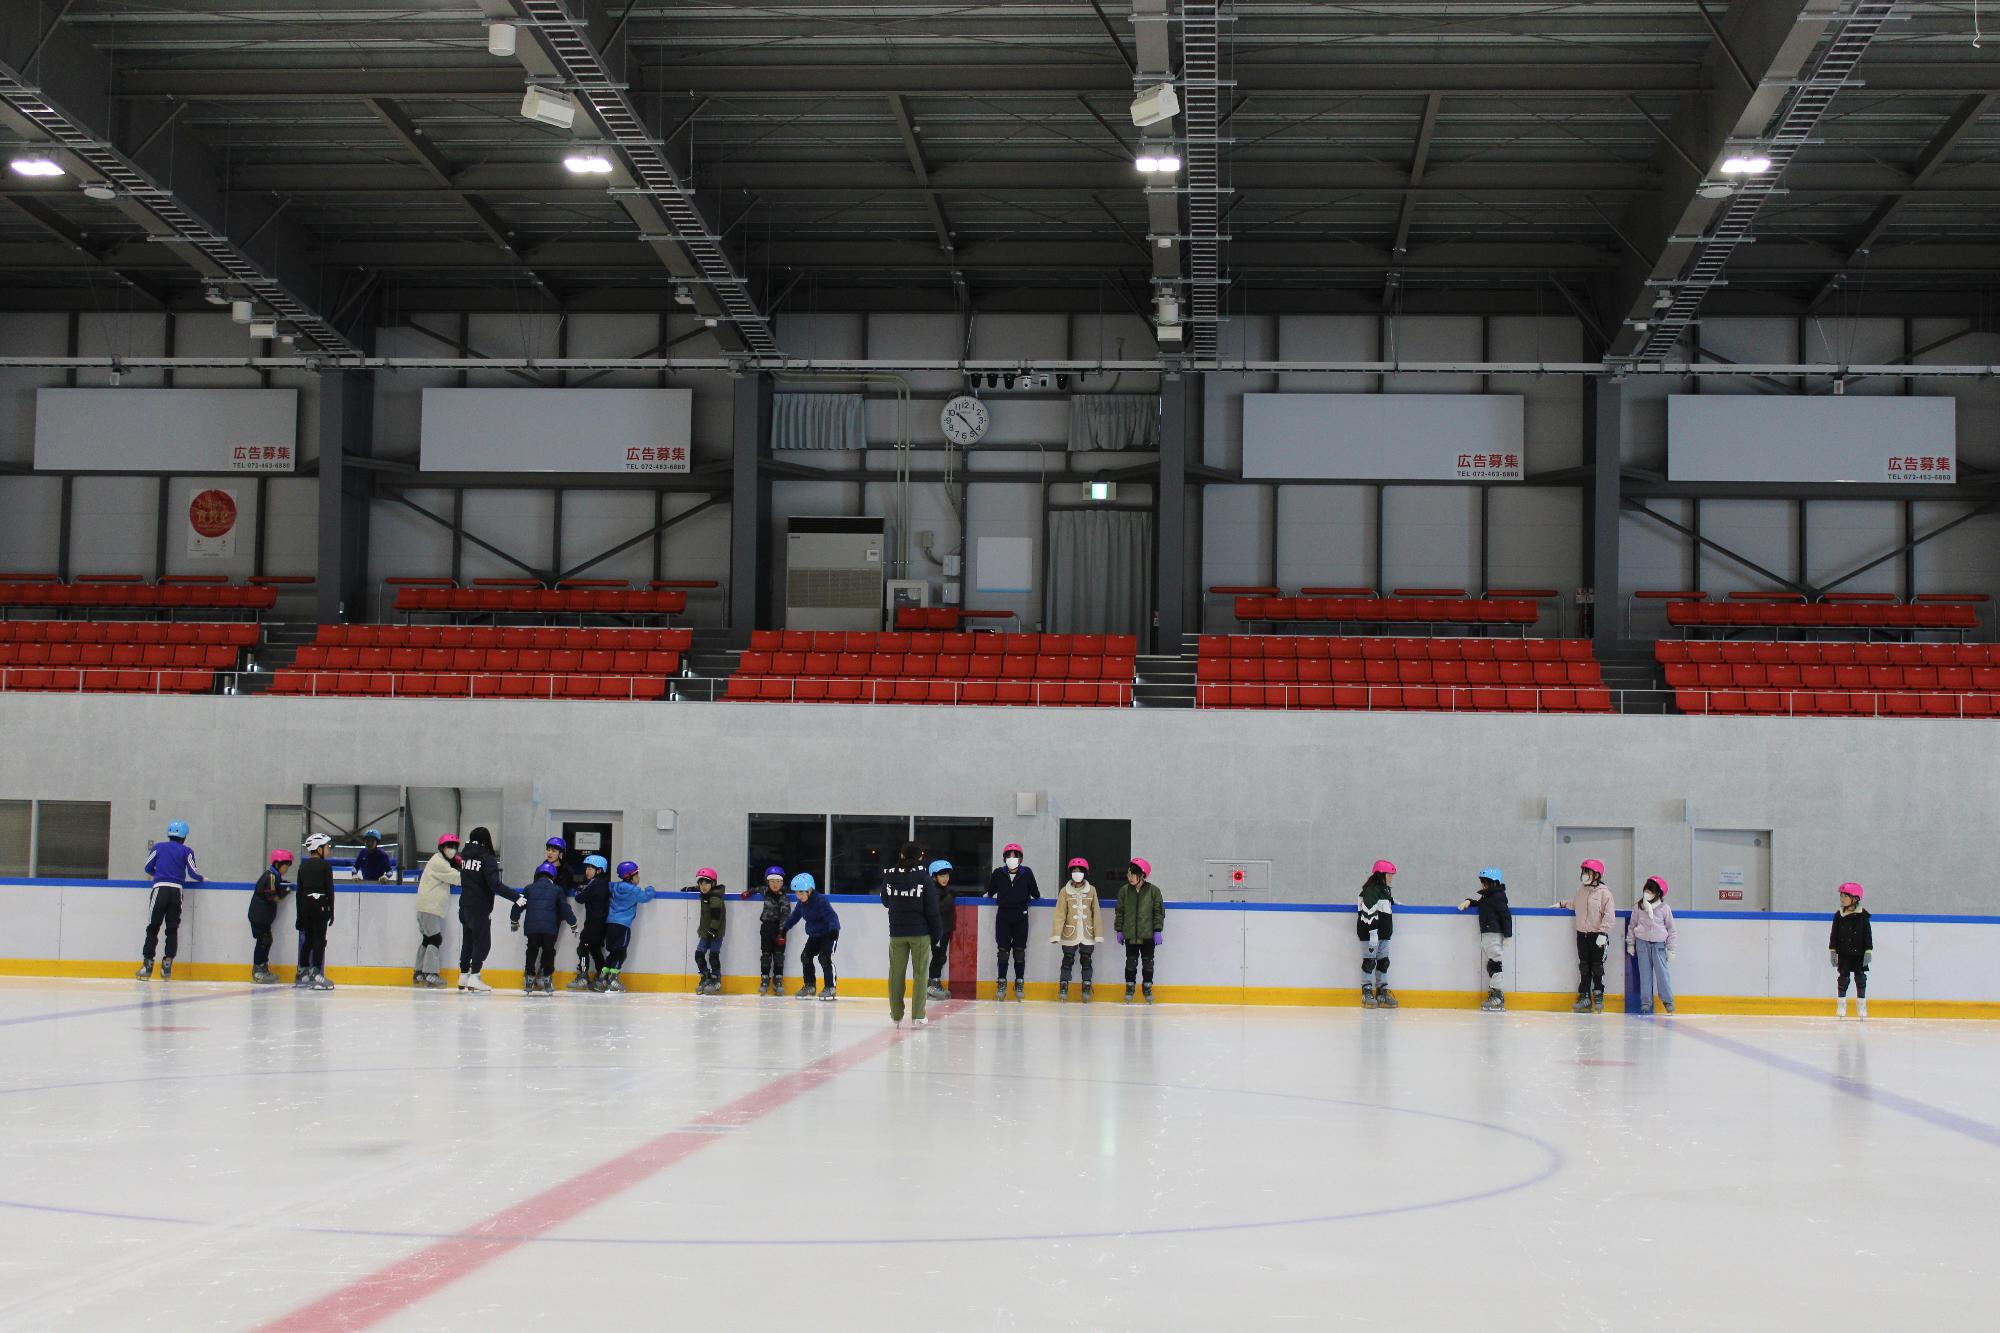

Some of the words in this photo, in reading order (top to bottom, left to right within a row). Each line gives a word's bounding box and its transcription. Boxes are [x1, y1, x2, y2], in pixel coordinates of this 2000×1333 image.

[234, 446, 290, 460] 広告募集
[627, 447, 685, 461] 広告募集
[1458, 454, 1518, 468] 広告募集
[1888, 457, 1950, 471] 広告募集
